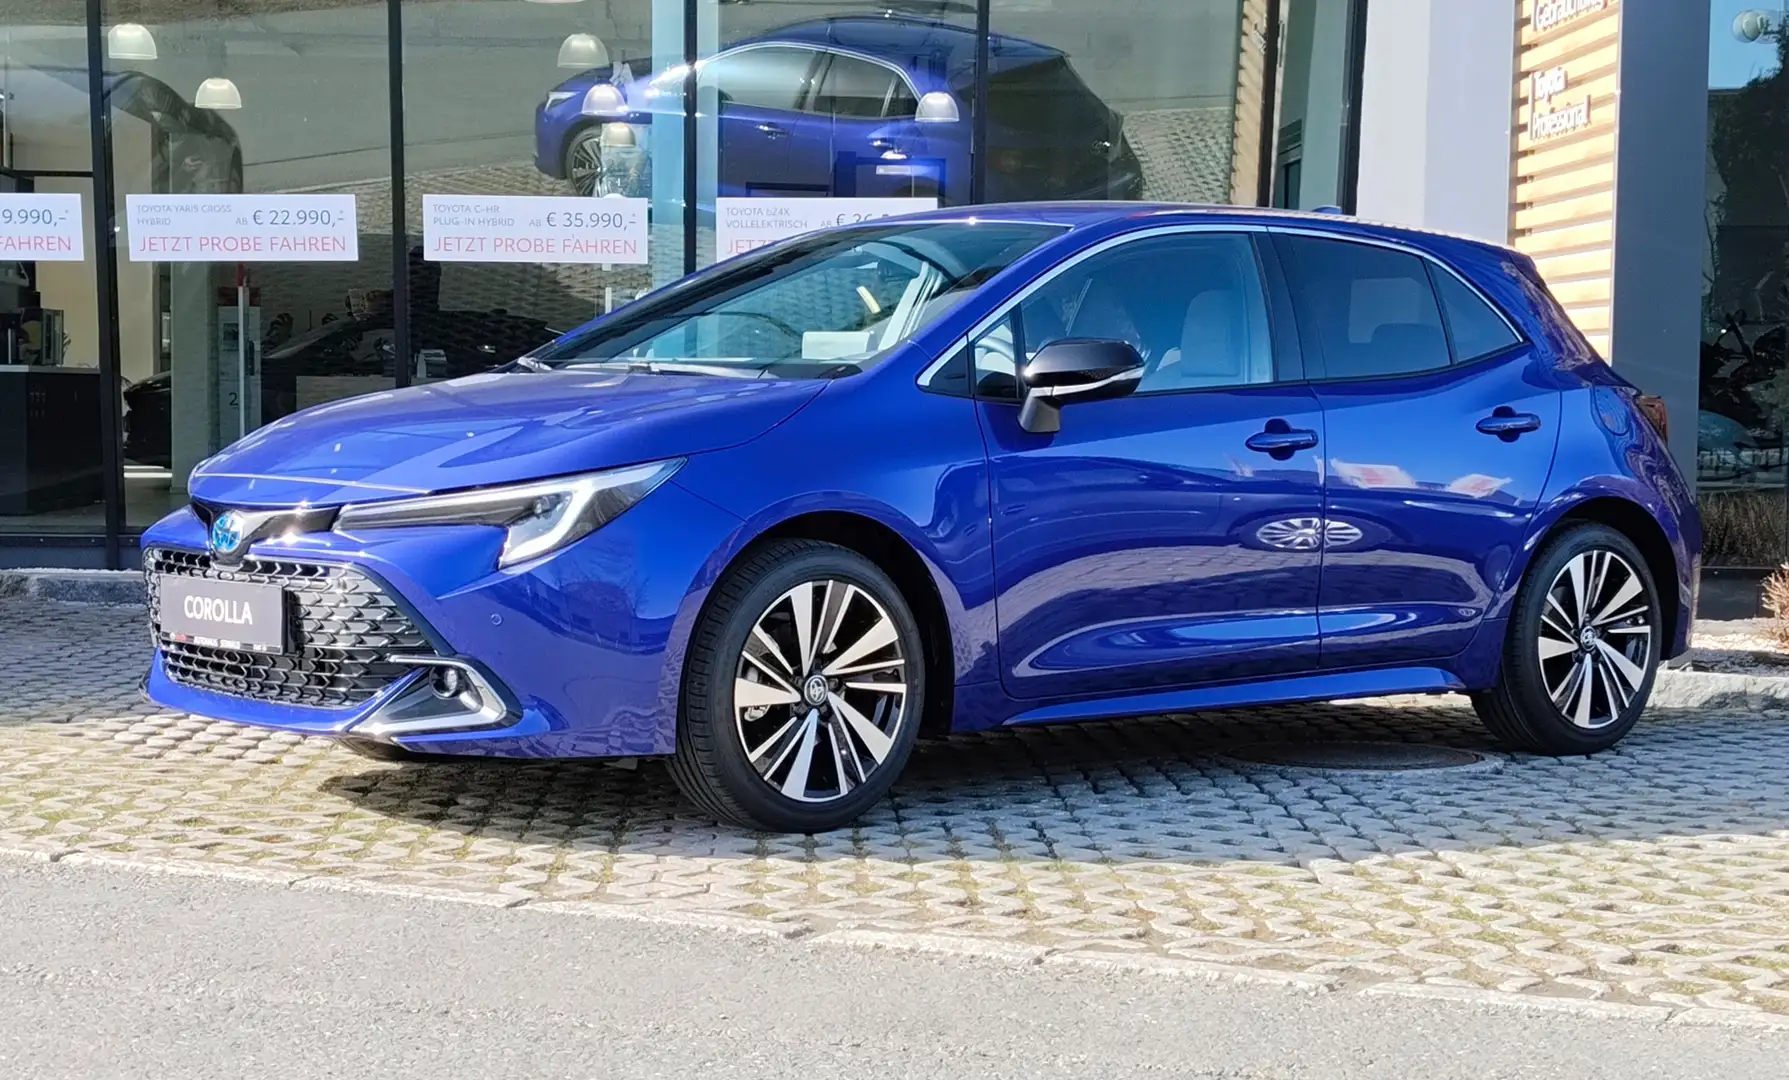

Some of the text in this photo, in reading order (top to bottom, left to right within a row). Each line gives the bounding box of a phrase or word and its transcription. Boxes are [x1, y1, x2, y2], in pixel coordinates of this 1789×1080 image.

[1533, 67, 1566, 103] Toyota
[1531, 96, 1589, 139] Professional
[136, 204, 232, 213] TOYOTA YARIS CROSS
[432, 204, 500, 213] TOYOTA C-HR
[726, 207, 791, 216] TOYOTA bZ4X
[136, 217, 171, 226] HYBRID
[235, 217, 248, 226] AB
[253, 209, 264, 226] €
[433, 216, 515, 227] PLUG-IN HYBRID
[528, 218, 542, 227] AB
[546, 212, 557, 227] €
[725, 220, 808, 229] VOLLELEKTRISCH
[139, 235, 346, 252] JETZT PROBE FAHREN
[433, 236, 637, 254] JETZT PROBE FAHREN
[726, 237, 776, 254] JET
[229, 392, 239, 406] 2
[184, 595, 253, 625] COROLLA
